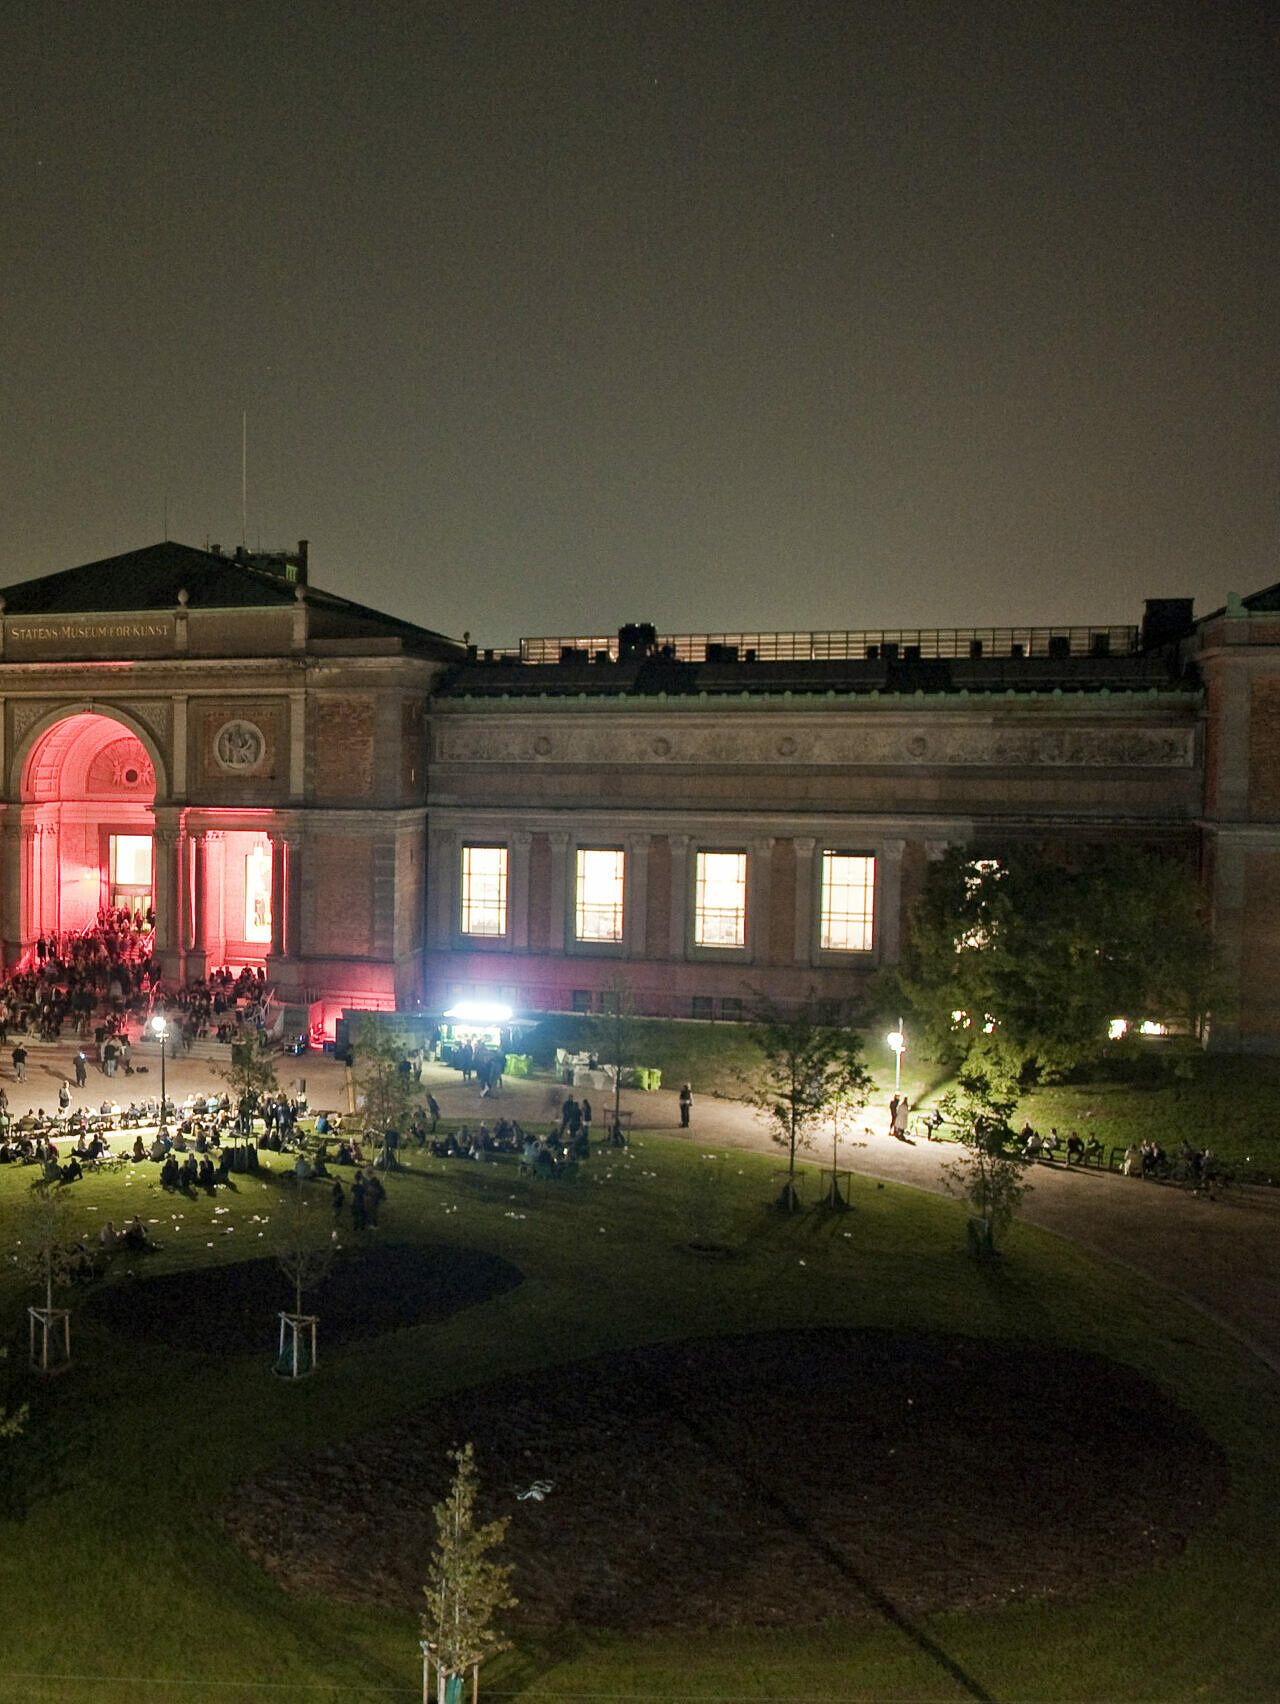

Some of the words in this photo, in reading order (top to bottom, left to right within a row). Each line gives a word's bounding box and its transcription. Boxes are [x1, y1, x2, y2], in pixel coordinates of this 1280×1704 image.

[11, 627, 58, 640] STATENS
[62, 626, 107, 639] MUSEUM
[110, 626, 130, 637] FOR
[133, 625, 168, 637] KUNST
